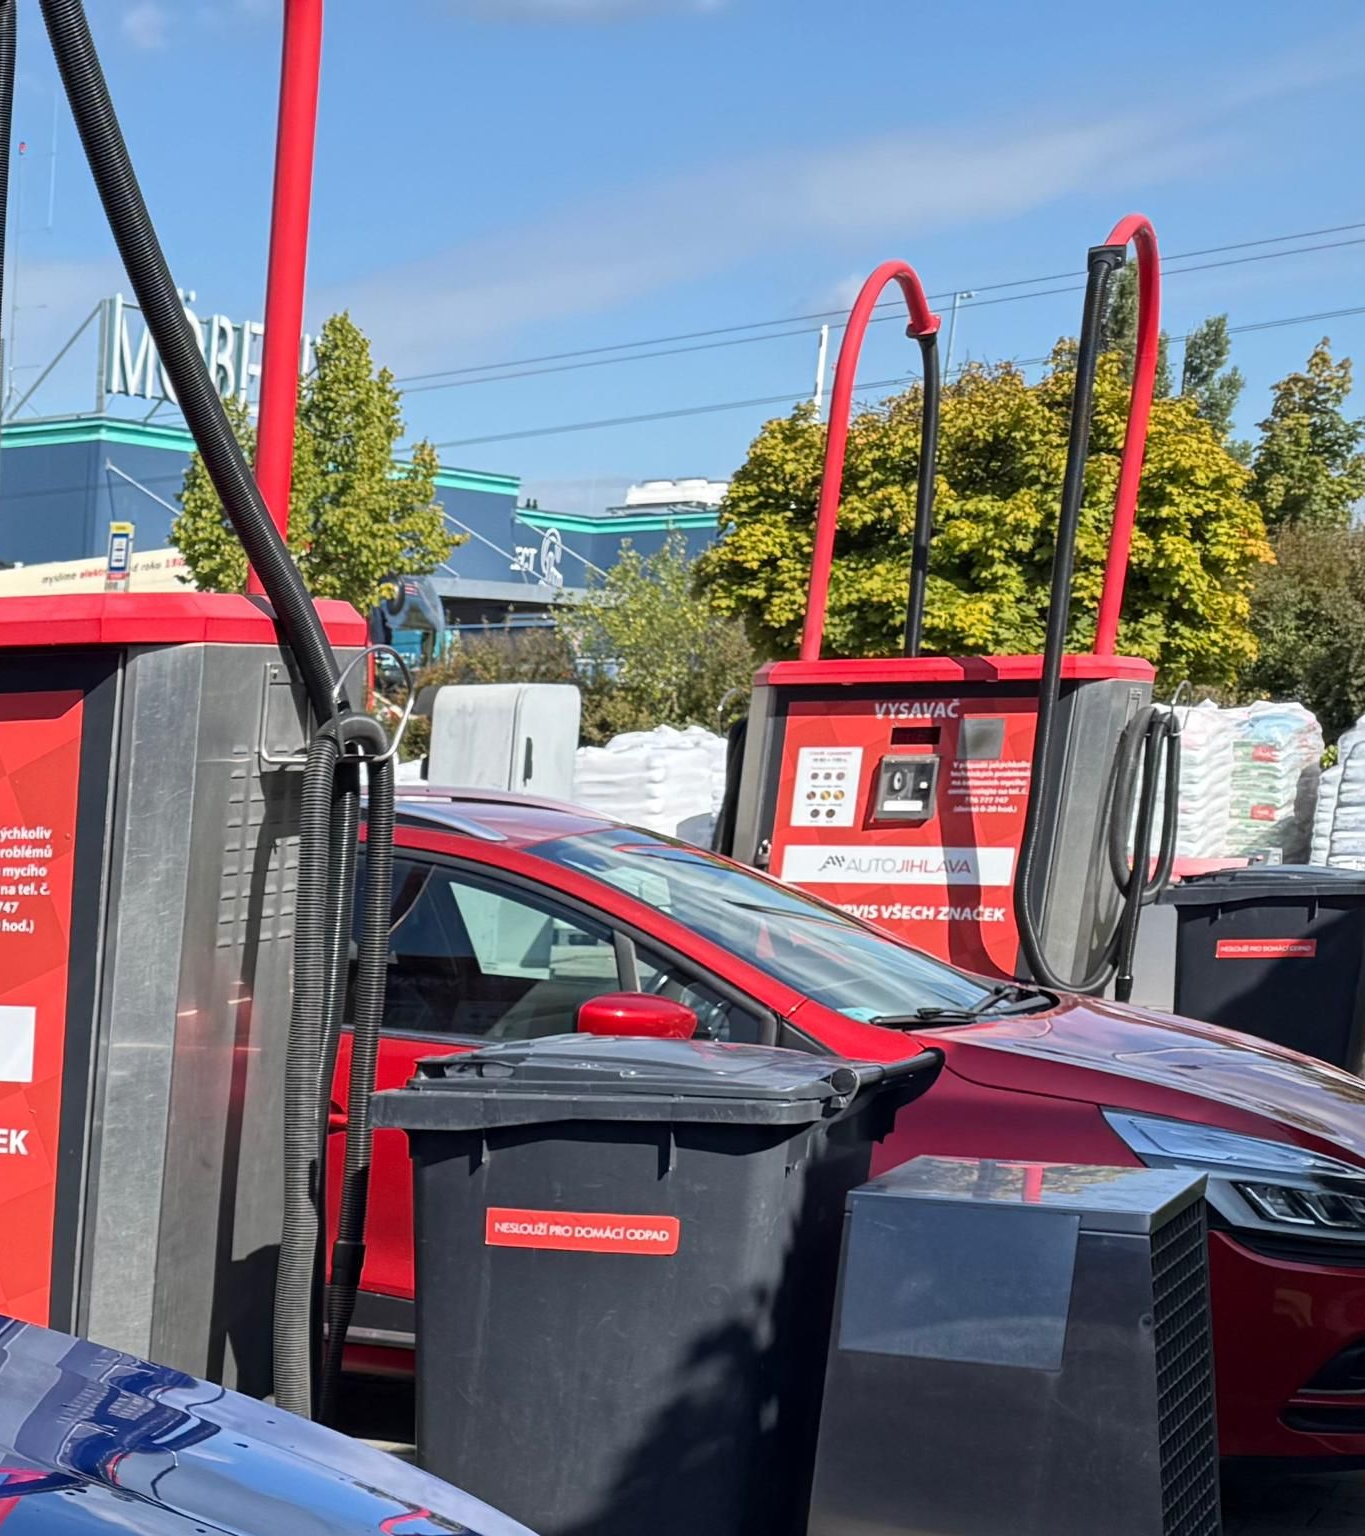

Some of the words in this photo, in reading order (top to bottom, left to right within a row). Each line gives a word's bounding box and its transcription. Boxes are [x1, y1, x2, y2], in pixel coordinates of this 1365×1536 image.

[874, 699, 960, 720] VYSAVAČ
[3, 864, 47, 880] mycího
[845, 856, 971, 876] AUTOJIHLAVA
[0, 885, 16, 895] na
[18, 883, 38, 895] tel.
[40, 883, 51, 895] č.
[881, 903, 934, 920] VŠECH
[937, 904, 1005, 921] ZNAČEK
[2, 919, 35, 934] hod.)
[494, 1221, 547, 1236] NESLOUŽÍ
[549, 1225, 573, 1237] PRO
[574, 1224, 624, 1240] DOMÁCÍ
[626, 1228, 669, 1242] ODPAD
